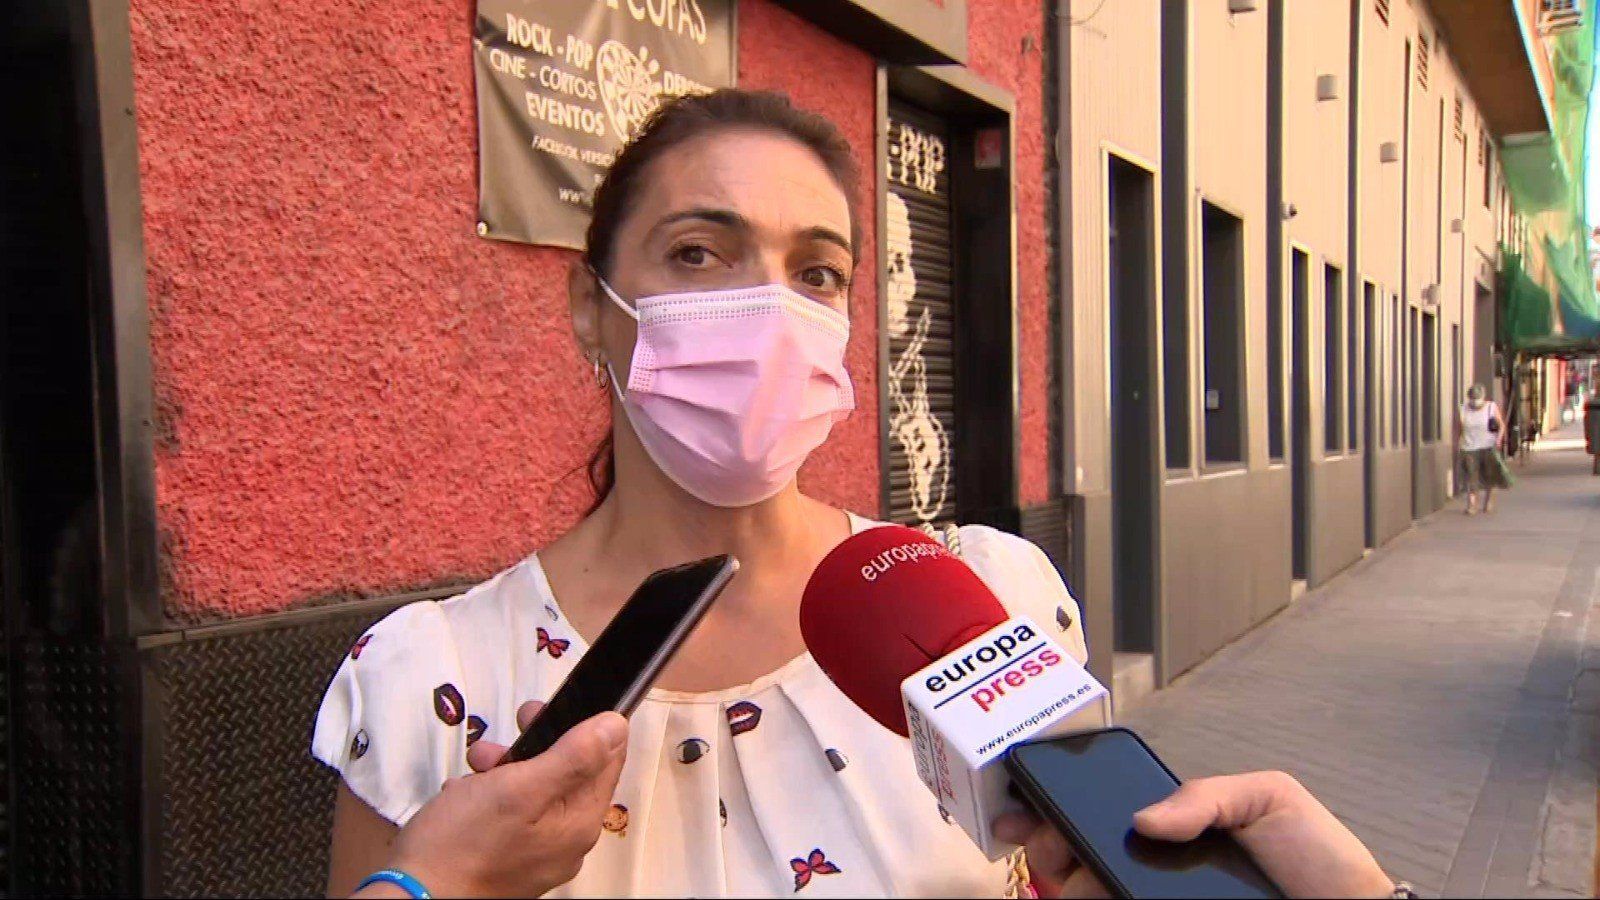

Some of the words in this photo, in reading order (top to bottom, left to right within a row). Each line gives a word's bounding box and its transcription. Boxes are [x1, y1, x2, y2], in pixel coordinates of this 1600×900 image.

[506, 13, 554, 56] ROCK
[566, 34, 594, 70] POP
[490, 48, 526, 79] CINE
[540, 65, 598, 101] CORTOS
[526, 91, 605, 136] EVENTOS
[925, 624, 1036, 692] europa
[970, 650, 1062, 712] press
[976, 683, 1092, 755] www.europapress.es
